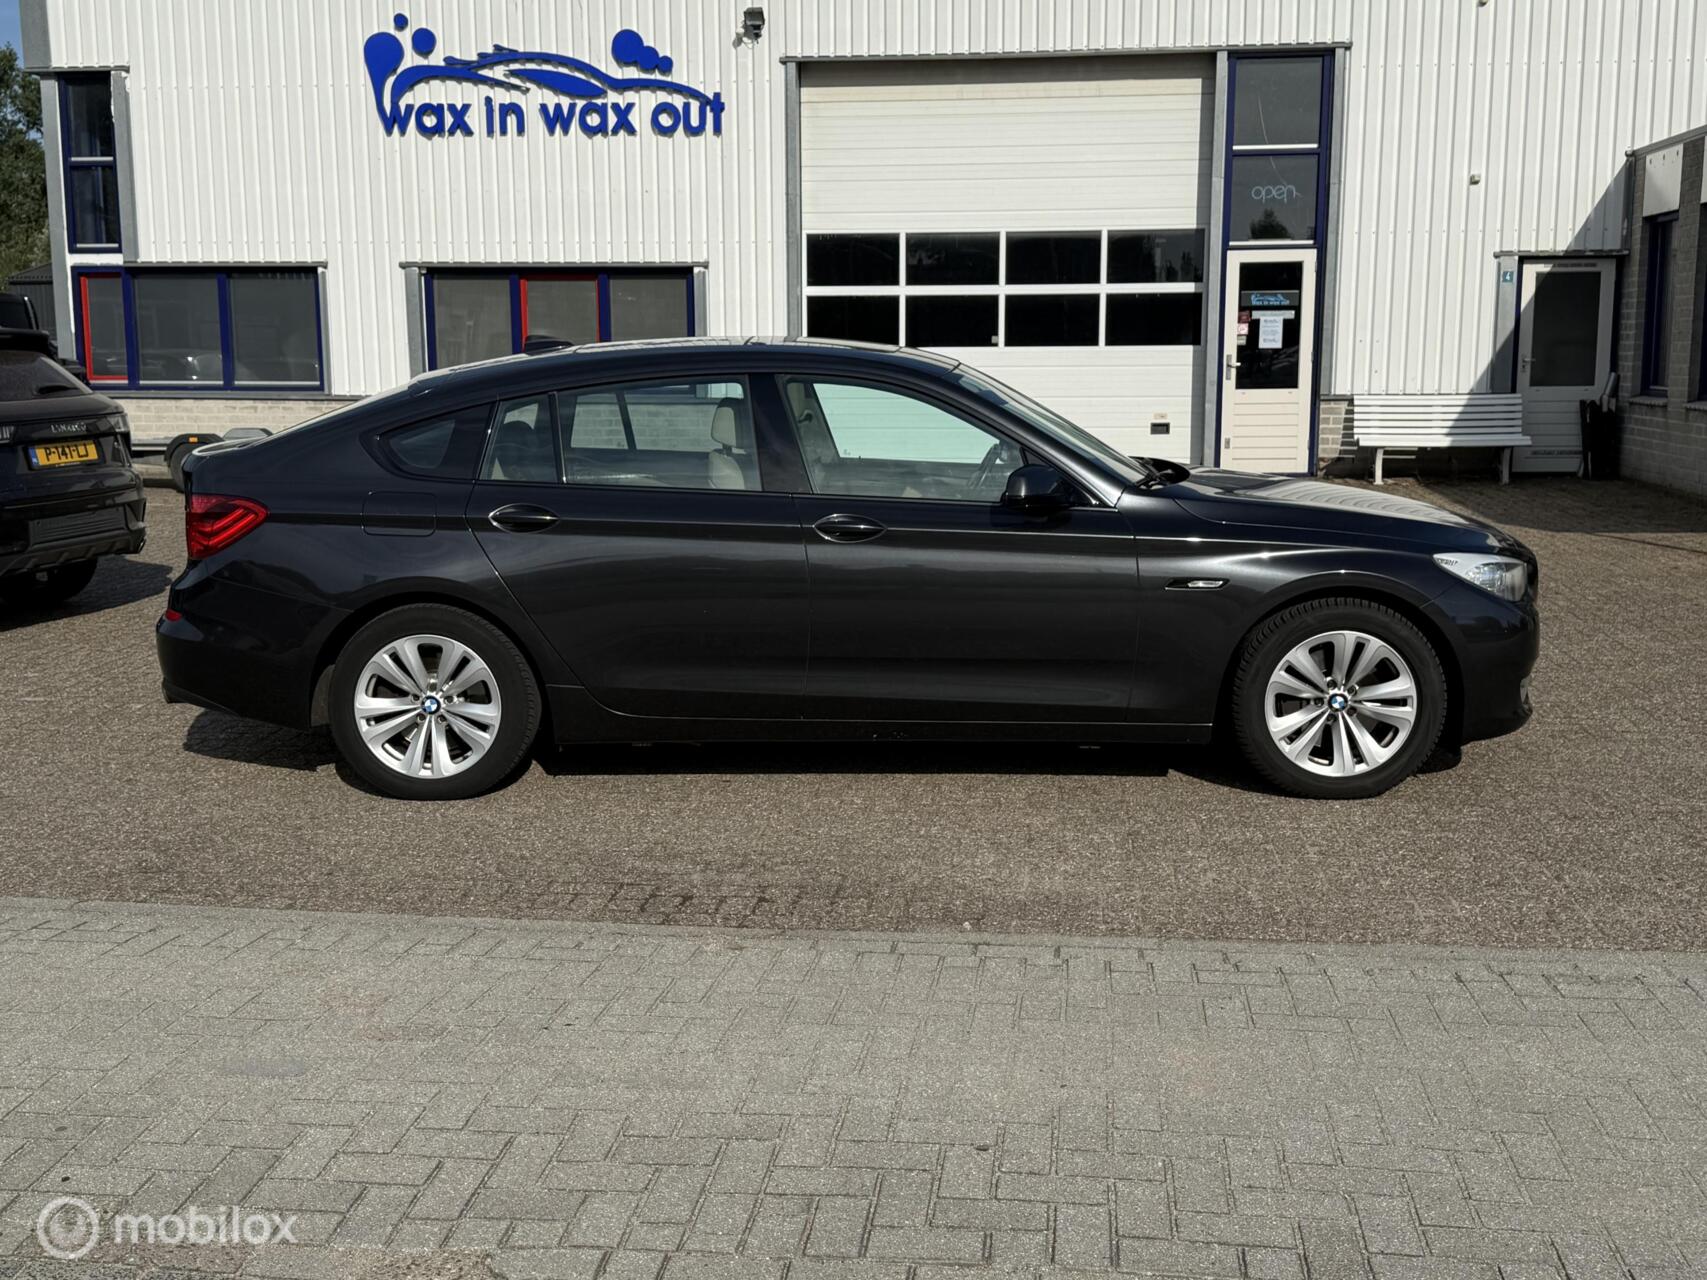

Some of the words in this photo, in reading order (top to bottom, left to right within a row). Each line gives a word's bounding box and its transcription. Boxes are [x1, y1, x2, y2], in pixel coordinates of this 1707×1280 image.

[379, 101, 473, 137] wax
[484, 95, 526, 137] in
[540, 100, 637, 137] wax
[651, 92, 725, 137] out
[1251, 184, 1296, 204] open
